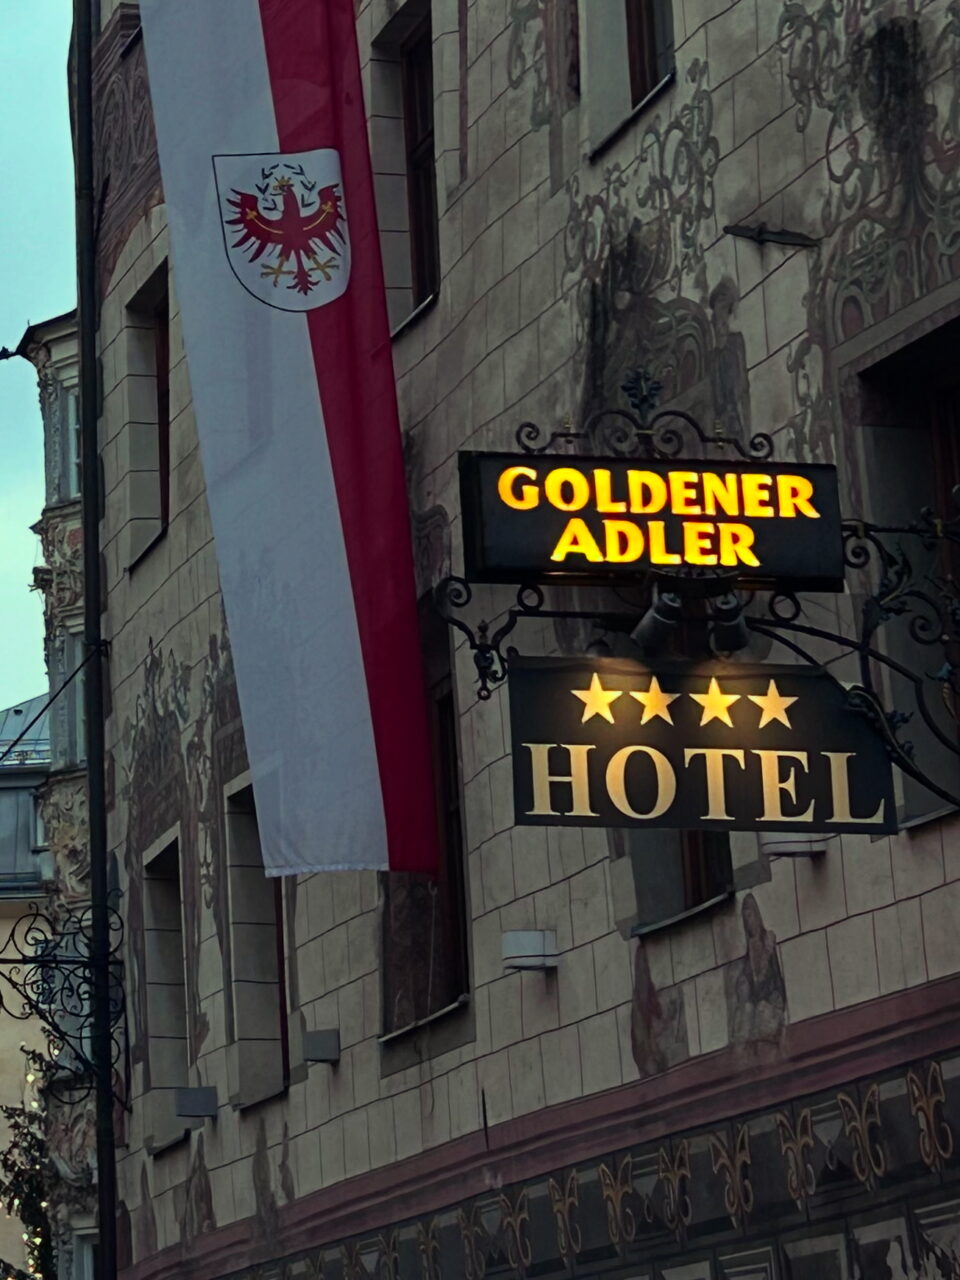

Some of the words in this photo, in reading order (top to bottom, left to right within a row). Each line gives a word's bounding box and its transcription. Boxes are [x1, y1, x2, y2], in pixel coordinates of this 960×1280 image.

[498, 466, 820, 518] GOLDENER
[550, 518, 760, 567] ADLER
[521, 743, 885, 824] HOTEL
